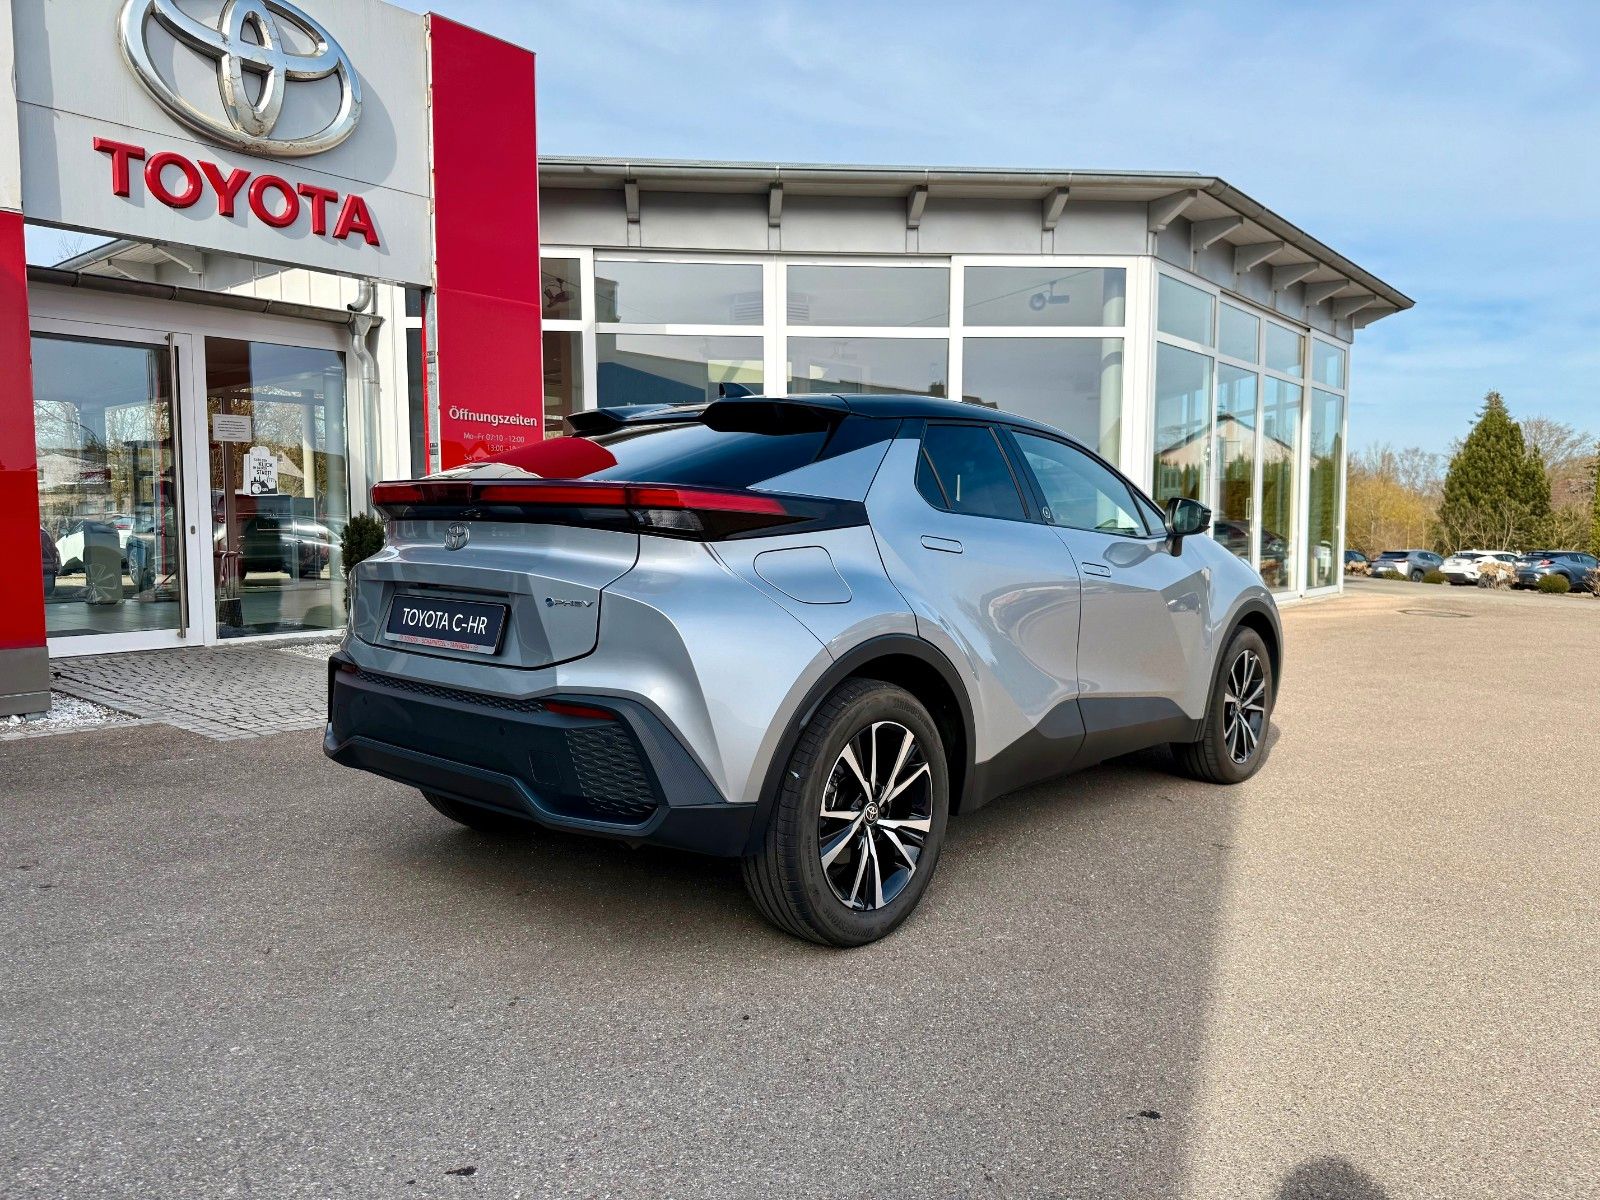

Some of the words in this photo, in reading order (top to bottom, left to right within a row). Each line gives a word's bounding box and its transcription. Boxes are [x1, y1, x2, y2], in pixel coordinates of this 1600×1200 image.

[93, 137, 380, 246] TOYOTA
[449, 405, 537, 426] Öffnungszeiten
[402, 607, 449, 630] TOYOTA
[452, 613, 488, 635] C-HR
